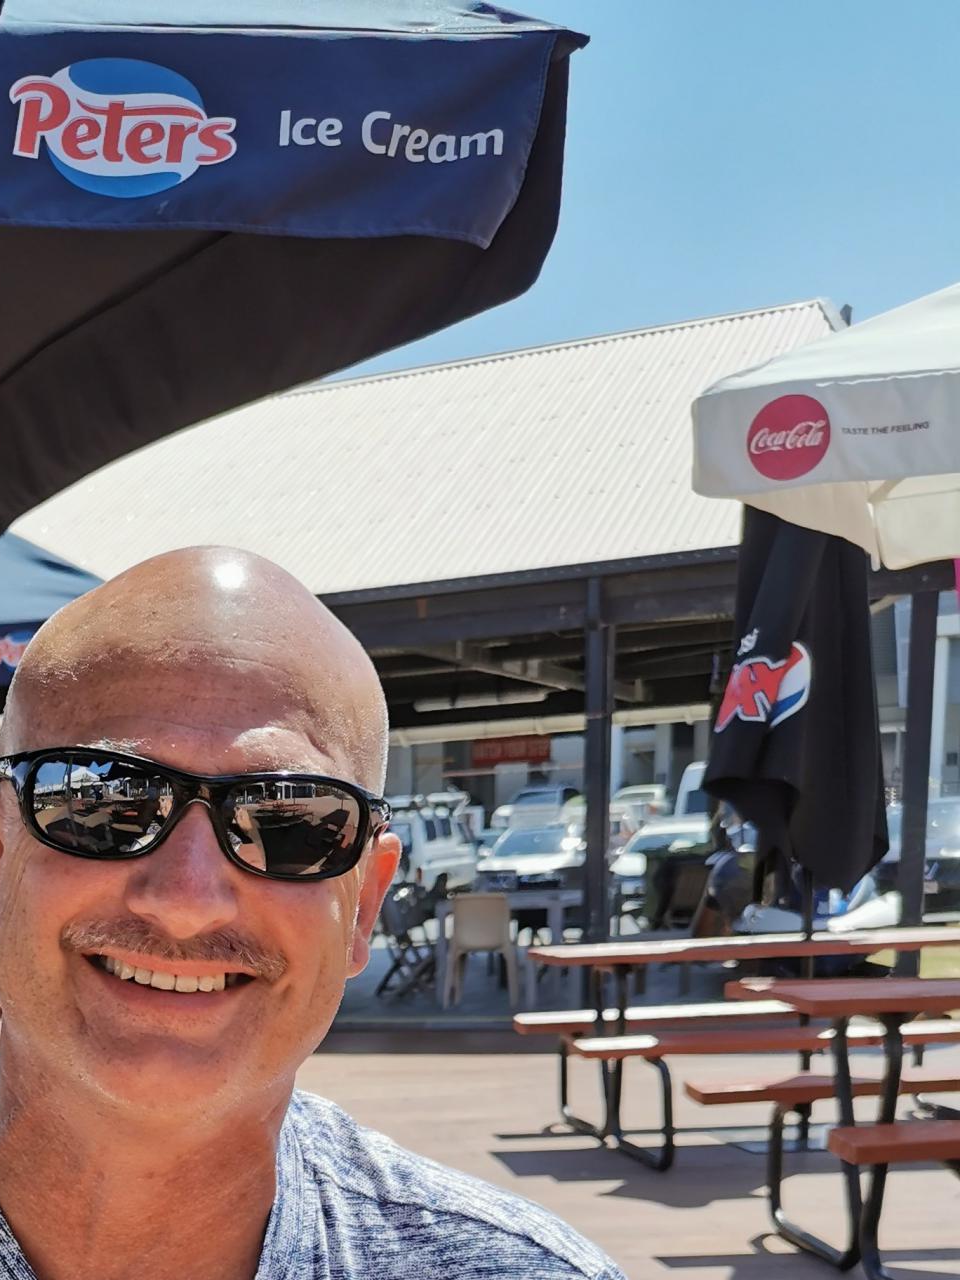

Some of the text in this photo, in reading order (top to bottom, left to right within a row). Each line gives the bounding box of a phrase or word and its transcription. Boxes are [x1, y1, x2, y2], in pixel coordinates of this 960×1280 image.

[11, 78, 235, 165] Peters
[278, 109, 505, 164] Ice Cream
[841, 421, 931, 436] TASTE THE FEELING
